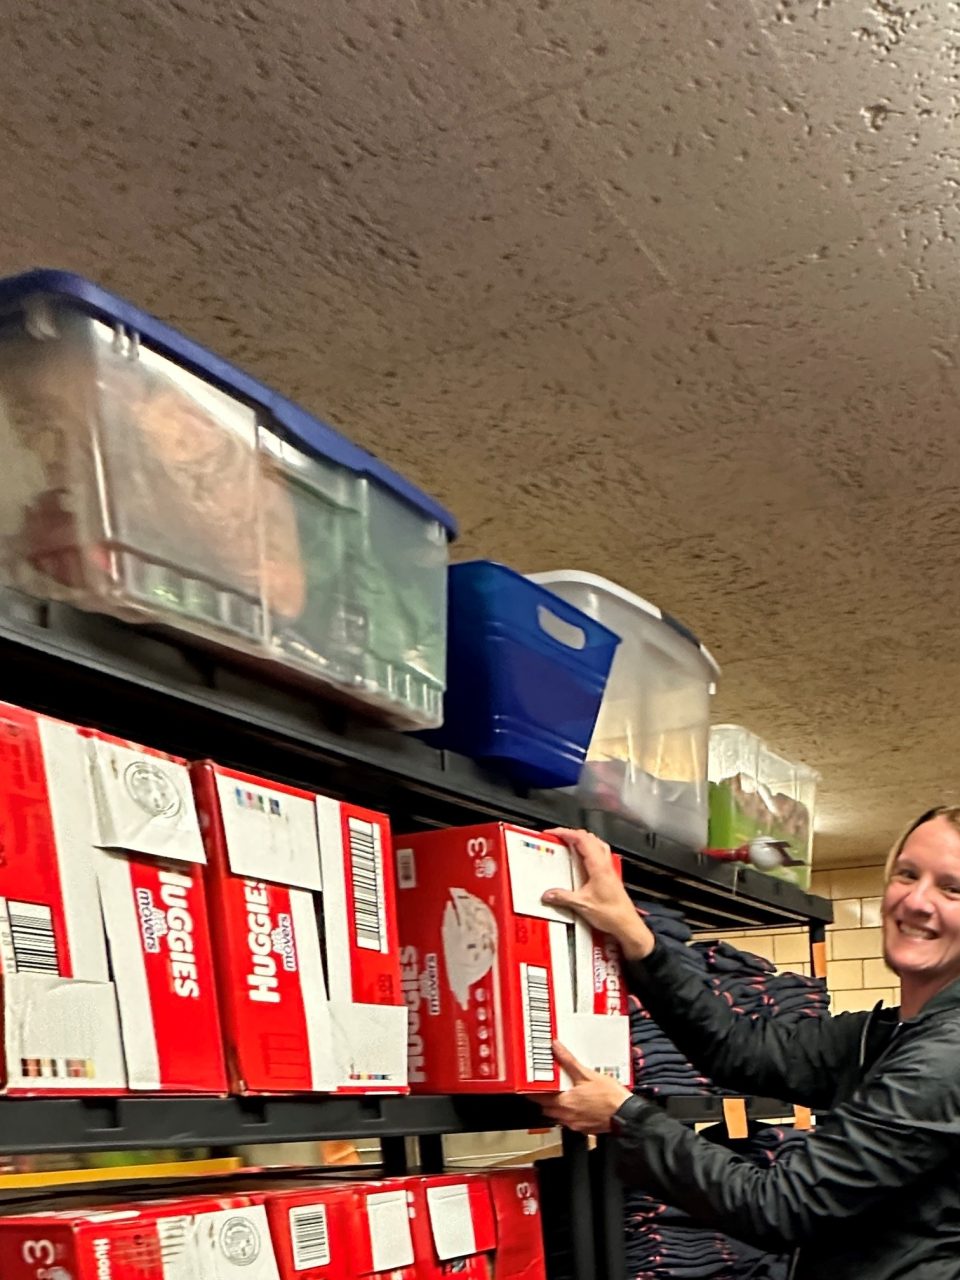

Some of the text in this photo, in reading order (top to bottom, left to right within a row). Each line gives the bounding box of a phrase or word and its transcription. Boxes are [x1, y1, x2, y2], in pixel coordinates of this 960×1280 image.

[467, 837, 488, 857] 3
[138, 889, 158, 951] movers
[282, 916, 295, 969] movers
[430, 955, 439, 1014] movers
[605, 945, 622, 1016] UGGIE
[400, 945, 426, 1083] HUGGIES
[516, 1182, 532, 1198] 3
[22, 1239, 55, 1265] 3
